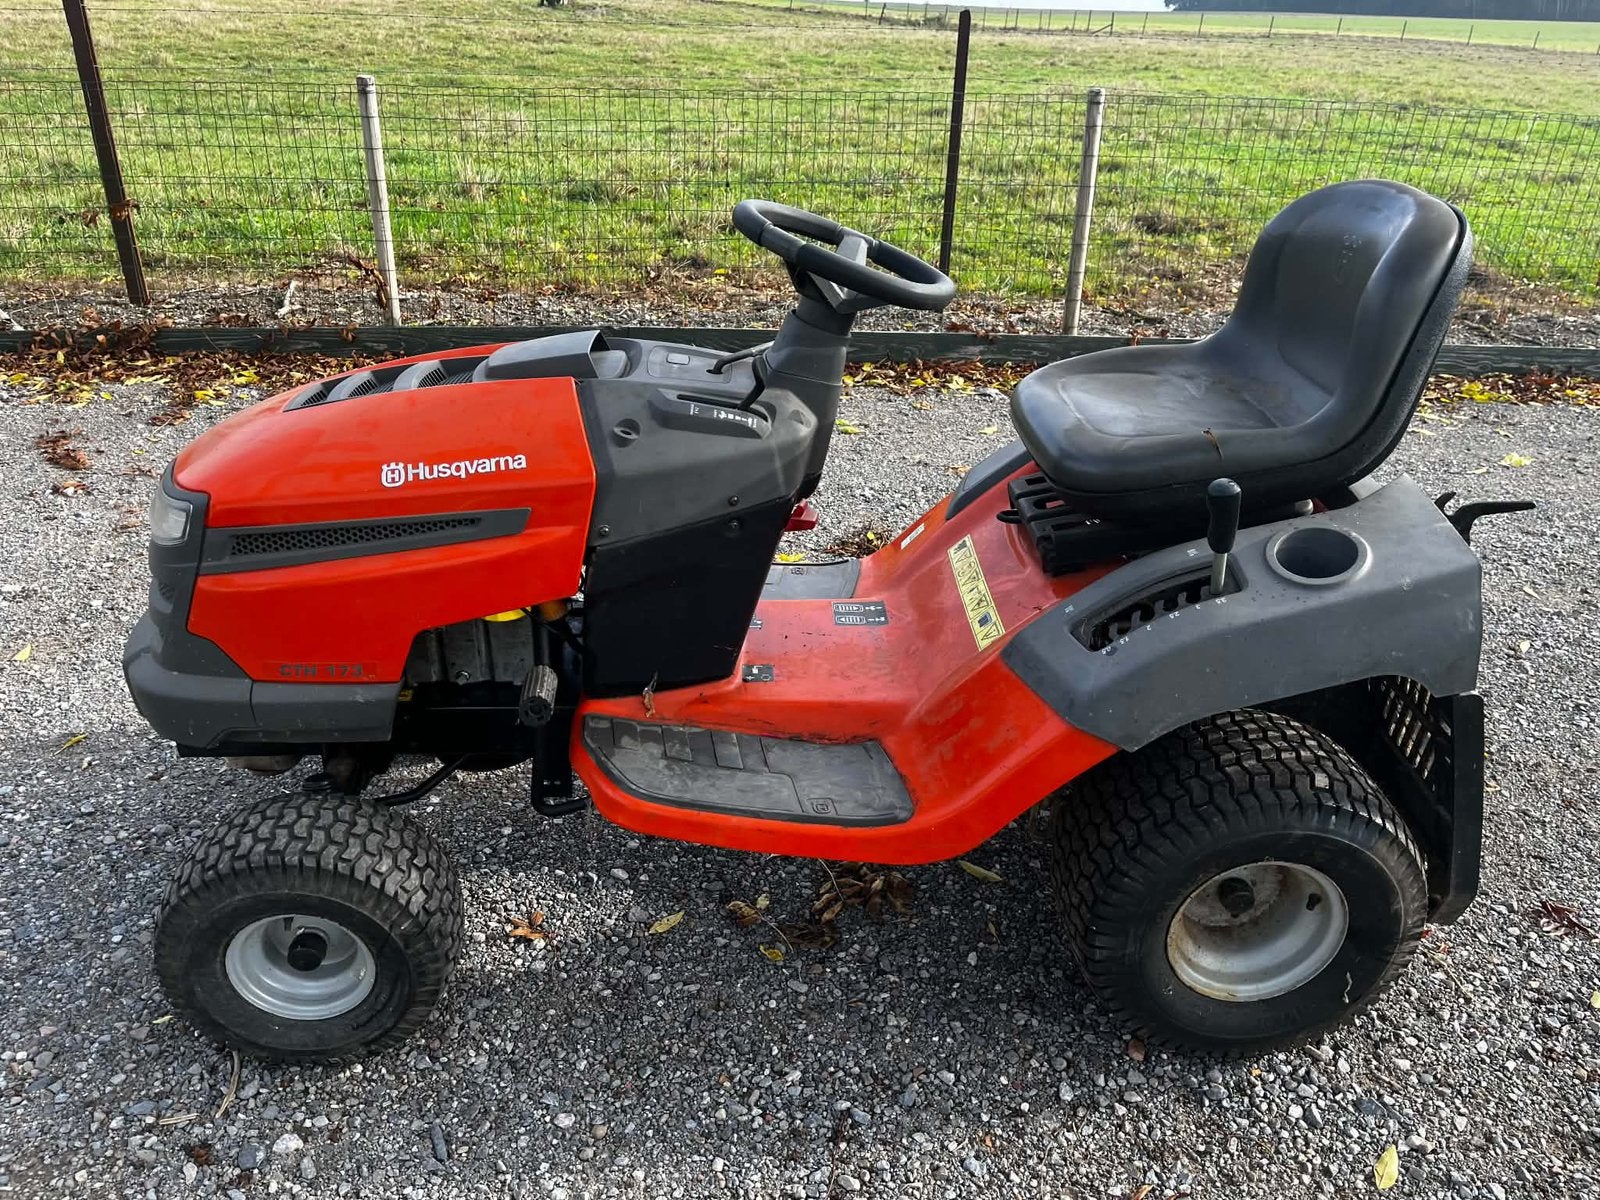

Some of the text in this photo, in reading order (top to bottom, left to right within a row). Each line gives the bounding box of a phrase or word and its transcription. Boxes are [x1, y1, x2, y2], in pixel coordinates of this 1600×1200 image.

[407, 454, 527, 481] Husqvarna
[279, 664, 363, 677] CTH 173
